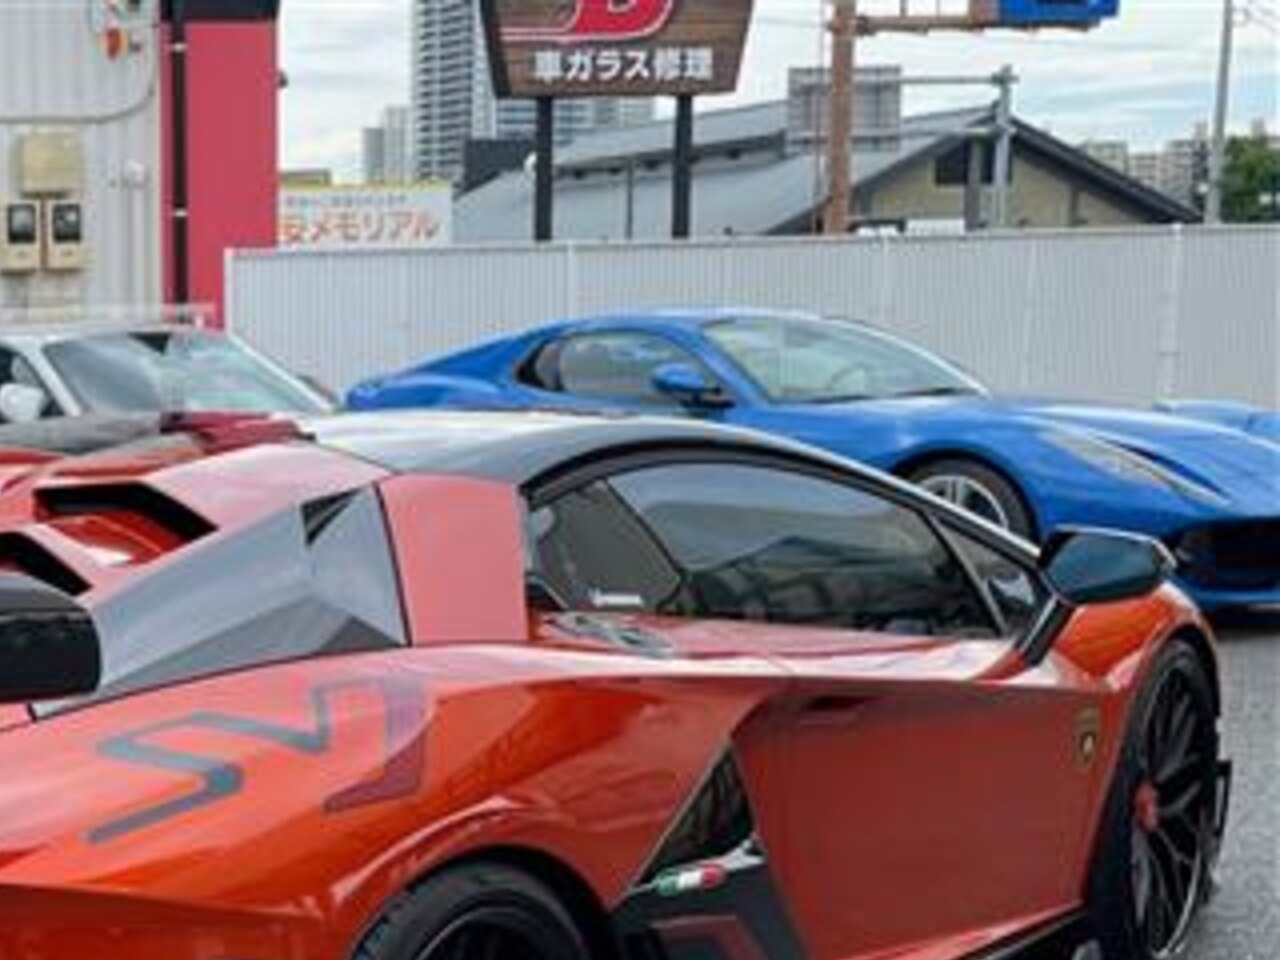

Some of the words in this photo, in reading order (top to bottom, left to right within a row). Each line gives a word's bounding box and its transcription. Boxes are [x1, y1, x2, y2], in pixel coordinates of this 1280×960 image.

[533, 48, 714, 80] 車ガラス修理
